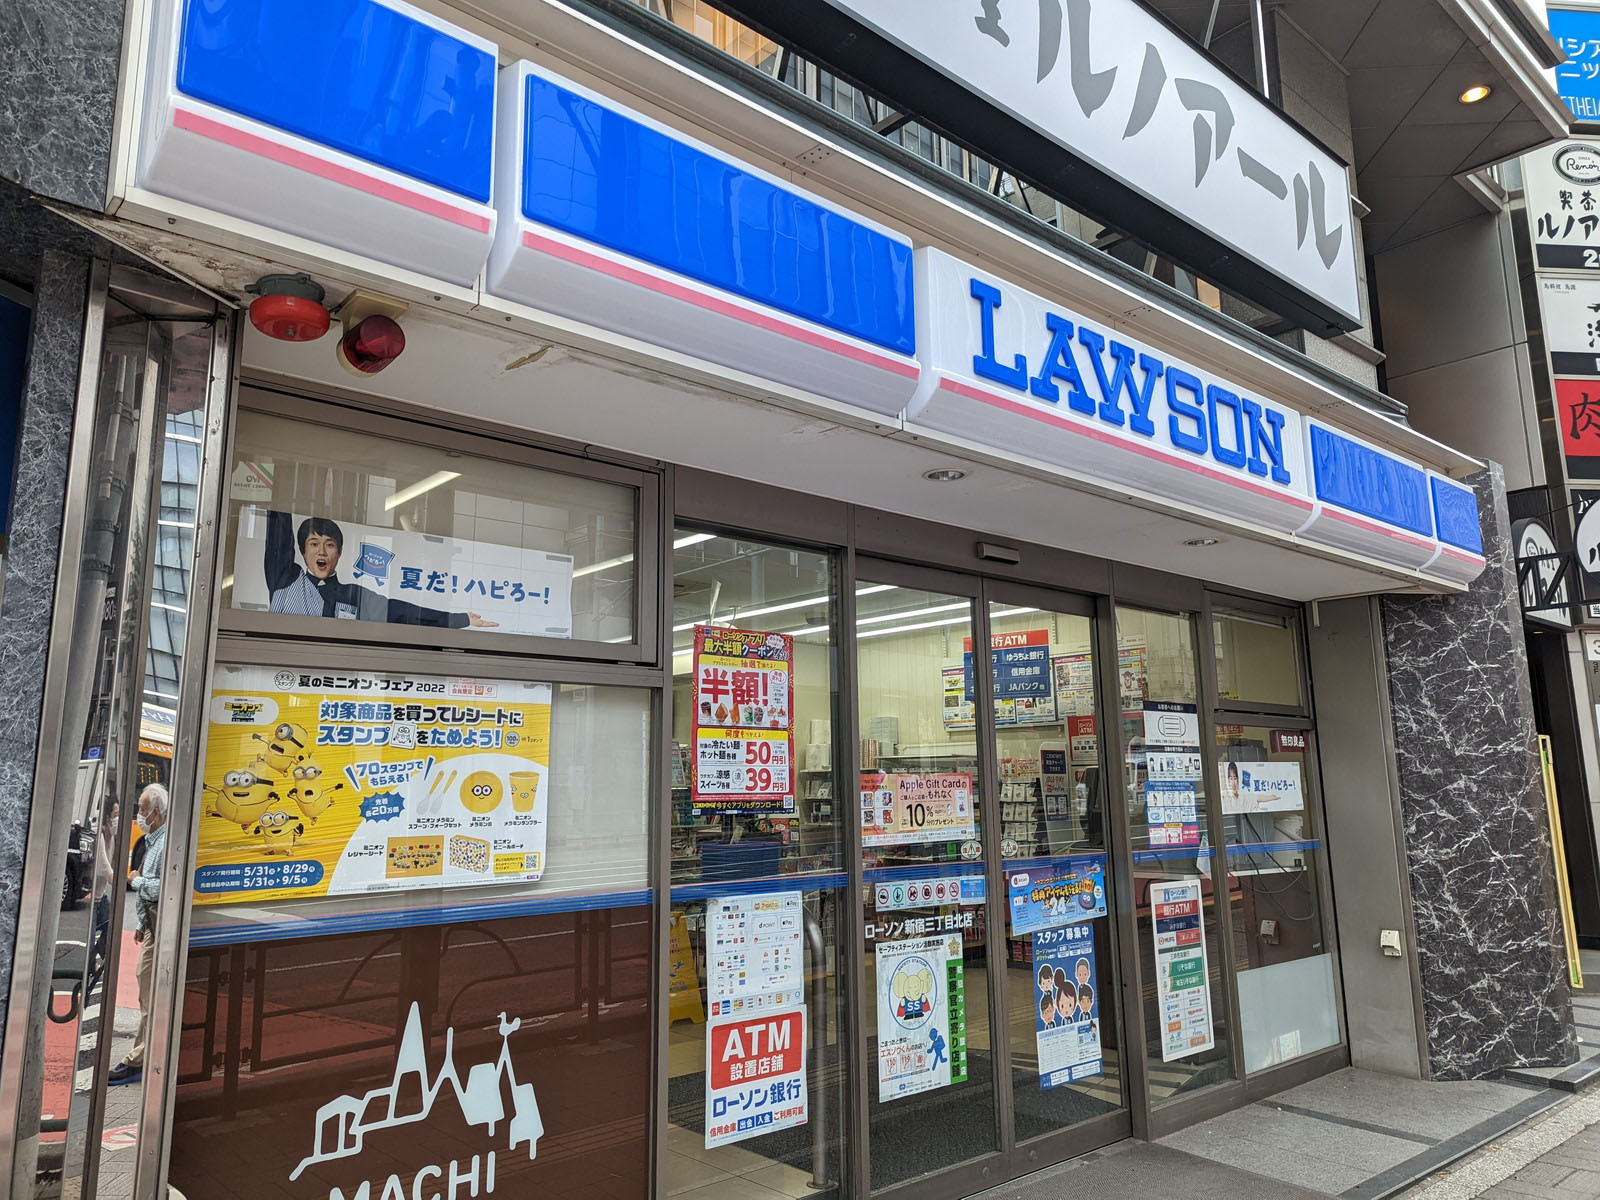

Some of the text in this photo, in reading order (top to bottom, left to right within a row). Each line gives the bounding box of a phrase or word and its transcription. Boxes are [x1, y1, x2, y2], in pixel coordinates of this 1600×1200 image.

[1561, 96, 1600, 116] THEI
[1583, 249, 1600, 268] 2
[970, 278, 1291, 486] LAWSON
[400, 566, 550, 605] 夏だ!ハピろー!
[1006, 651, 1045, 661] ゆうちょ銀行
[1011, 666, 1041, 677] 信用金庫
[298, 674, 414, 692] 夏のミニオン・フェア
[416, 682, 446, 693] 2022
[700, 667, 769, 707] 半額!
[1008, 682, 1039, 691] JAバンク
[320, 701, 521, 725] 対象商品を買ってレシートに
[317, 726, 501, 747] スタンプ をためよう!
[1281, 734, 1304, 747] 無印良品
[700, 751, 737, 760] ホット麺各種
[745, 741, 771, 765] 50
[356, 760, 424, 777] 70スタンプで
[370, 773, 409, 787] もらえる!
[700, 780, 731, 790] スイーツ各種
[745, 768, 771, 791] 39
[899, 780, 924, 792] Apple
[925, 780, 941, 789] Gift
[1163, 902, 1191, 916] 銀行ATM
[865, 912, 973, 939] ローソン新宿三丁目北店
[1037, 926, 1089, 945] スタッフ募集中
[907, 1001, 921, 1012] SS
[721, 1019, 791, 1062] ATM
[730, 1053, 784, 1081] 設置店舗
[713, 1078, 801, 1118] ローソン銀行
